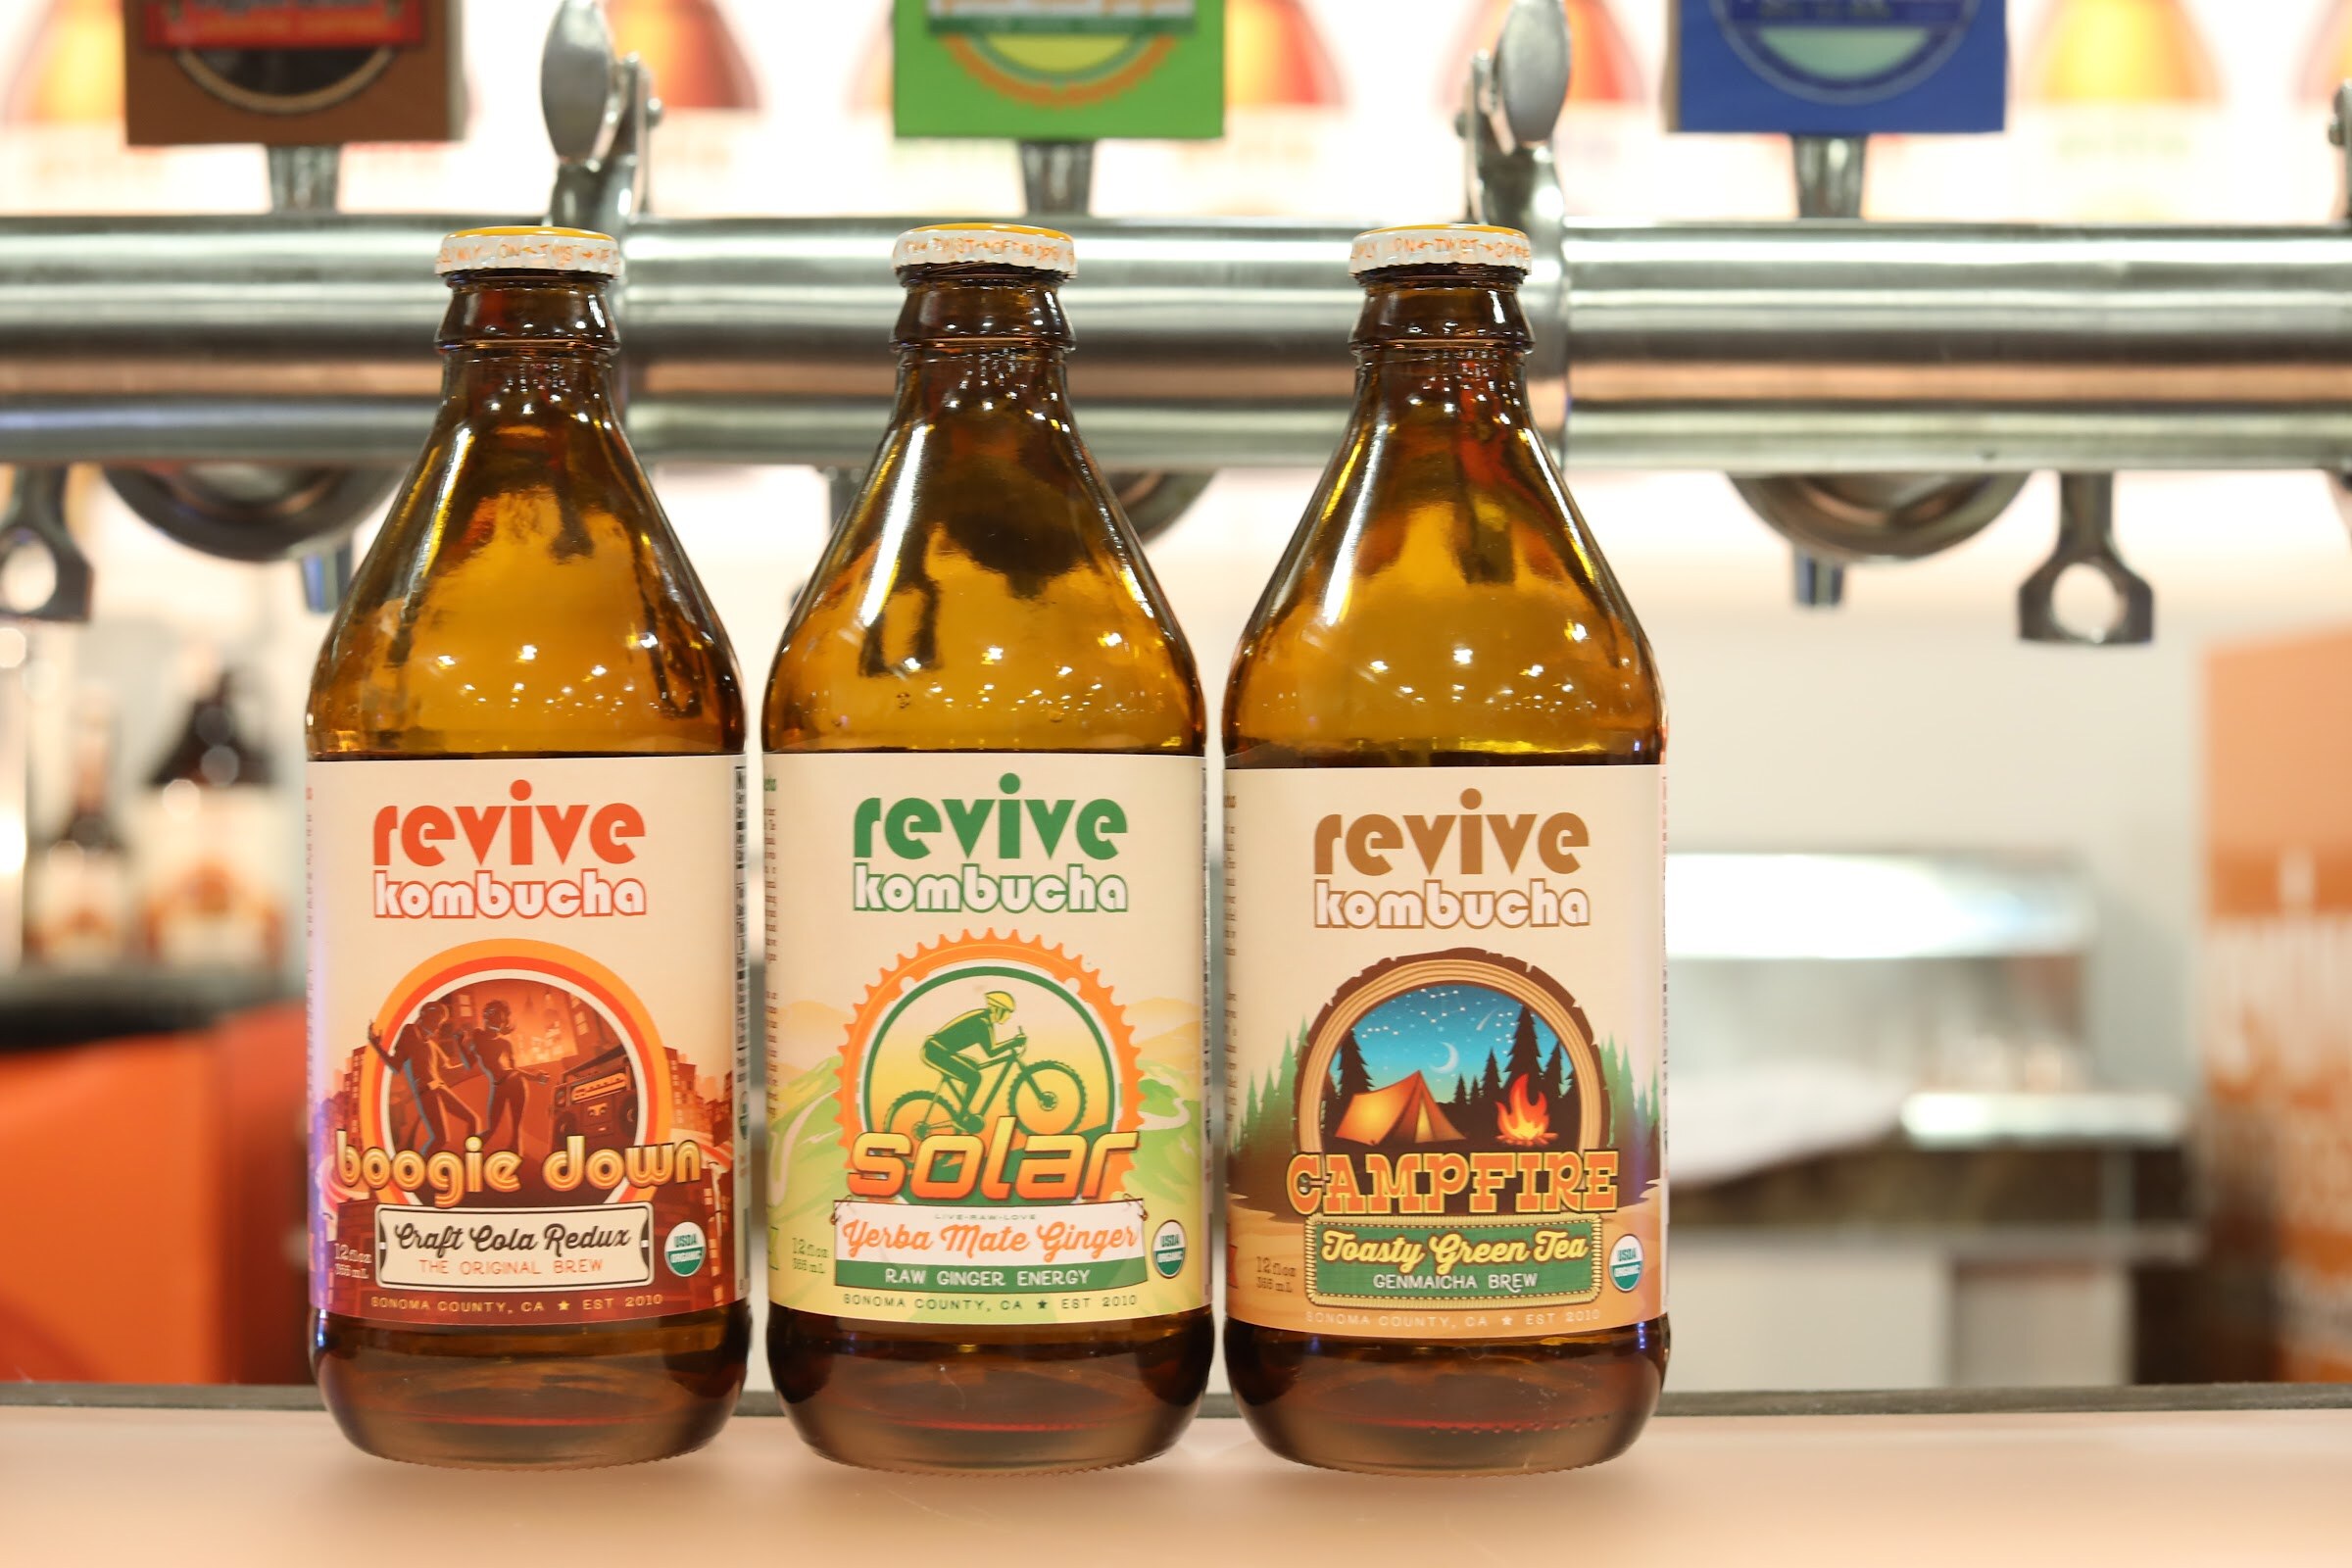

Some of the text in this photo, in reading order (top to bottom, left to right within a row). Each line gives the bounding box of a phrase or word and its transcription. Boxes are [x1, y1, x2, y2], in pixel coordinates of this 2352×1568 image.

[373, 779, 646, 866] revive
[854, 772, 1128, 859] revive
[1314, 787, 1590, 876] revive
[373, 868, 647, 918] kombucha
[854, 862, 1128, 913] kombucha
[1314, 878, 1591, 929] kombucha
[336, 1129, 702, 1209] boogie down
[847, 1115, 1140, 1200] solar
[1286, 1149, 1619, 1215] CAMPFIRE
[334, 1243, 349, 1260] 12
[394, 1223, 630, 1258] Craft Cola Redux
[673, 1234, 697, 1249] USDA
[842, 1218, 1138, 1263] Yerba Mate Ginger
[1160, 1234, 1180, 1248] USDA
[1321, 1229, 1590, 1276] Toasty Green Tea
[1617, 1248, 1637, 1261] USDA
[418, 1258, 603, 1275] THE ORIGINAL BREW
[885, 1267, 1091, 1286] RAW GINGER ENERGY
[1255, 1256, 1271, 1274] 12
[1373, 1272, 1539, 1294] GENMAICHA BREW
[370, 1294, 663, 1314] SONOMA COUNTY, CA EST 2010
[843, 1294, 1138, 1313] SONOMA COUNTY, CA EST 2010
[1304, 1308, 1600, 1329] SONOMA COUNTY, CA EST 2010
